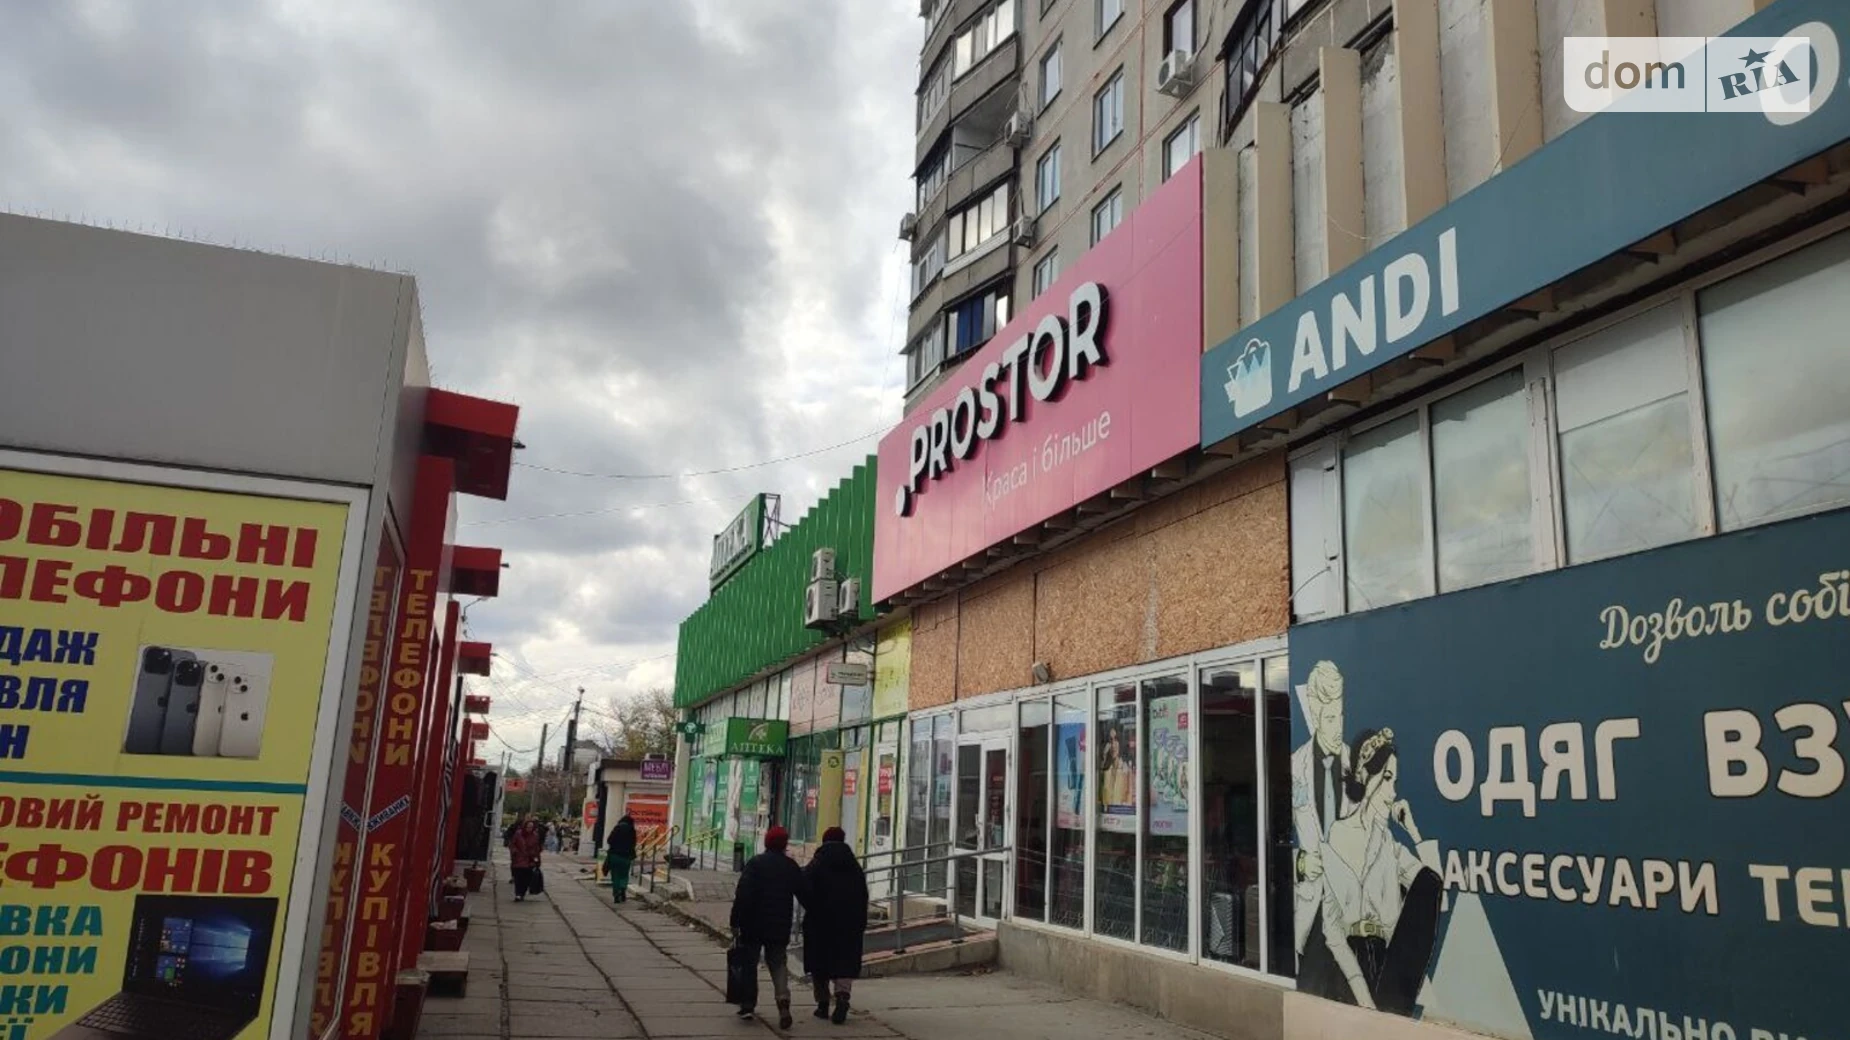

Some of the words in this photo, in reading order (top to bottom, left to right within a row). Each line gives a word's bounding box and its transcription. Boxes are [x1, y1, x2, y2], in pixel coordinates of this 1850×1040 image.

[1288, 227, 1459, 393] ANDI
[983, 462, 1028, 511] Краса
[1042, 411, 1111, 471] більше
[1600, 598, 1752, 664] Дозволь
[1766, 570, 1850, 626] собі
[0, 626, 99, 666] ДАЖ
[384, 569, 433, 766] ТЕЛЕФОНИ
[0, 675, 89, 713] ВЛЯ
[732, 742, 784, 754] АПТЕКА
[1433, 717, 1640, 817] ОДЯГ
[1703, 700, 1850, 798] ВЗ
[116, 802, 279, 836] РЕМОНТ
[0, 842, 273, 894] ФОНІВ
[1443, 849, 1719, 915] АКСЕСУАРИ
[1748, 863, 1850, 927] ТЕ
[0, 905, 103, 936] ВКА
[348, 843, 395, 1036] КУПІВЛЯ
[0, 946, 97, 974] ОНИ
[0, 985, 68, 1014] КИ
[1537, 989, 1737, 1040] УНІКАЛЬНО
